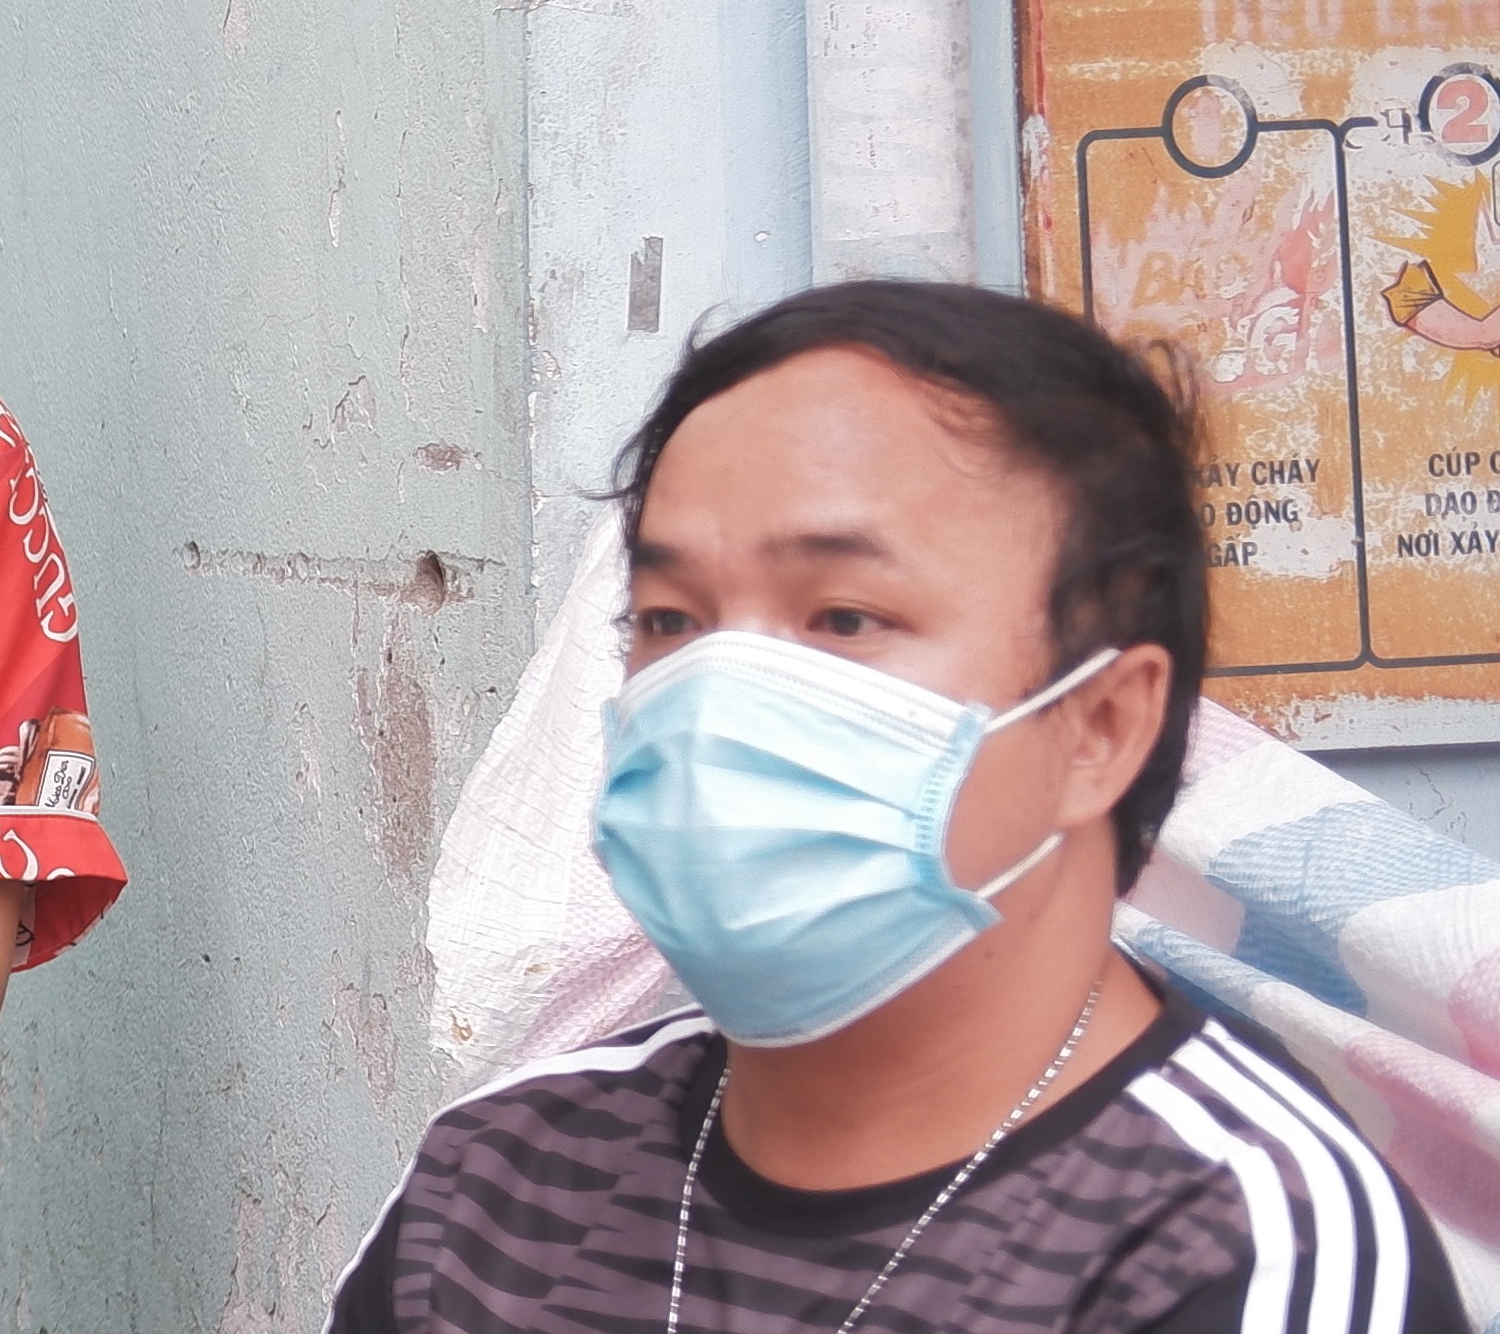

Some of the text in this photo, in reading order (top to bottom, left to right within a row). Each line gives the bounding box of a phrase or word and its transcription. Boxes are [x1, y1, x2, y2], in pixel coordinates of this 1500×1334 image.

[1437, 79, 1489, 144] 2
[1252, 452, 1321, 485] CHÁY
[1428, 446, 1480, 478] CÚP
[1226, 494, 1299, 531] ĐỘNG
[1424, 490, 1478, 517] DAO
[1397, 521, 1500, 558] NƠI XẢY
